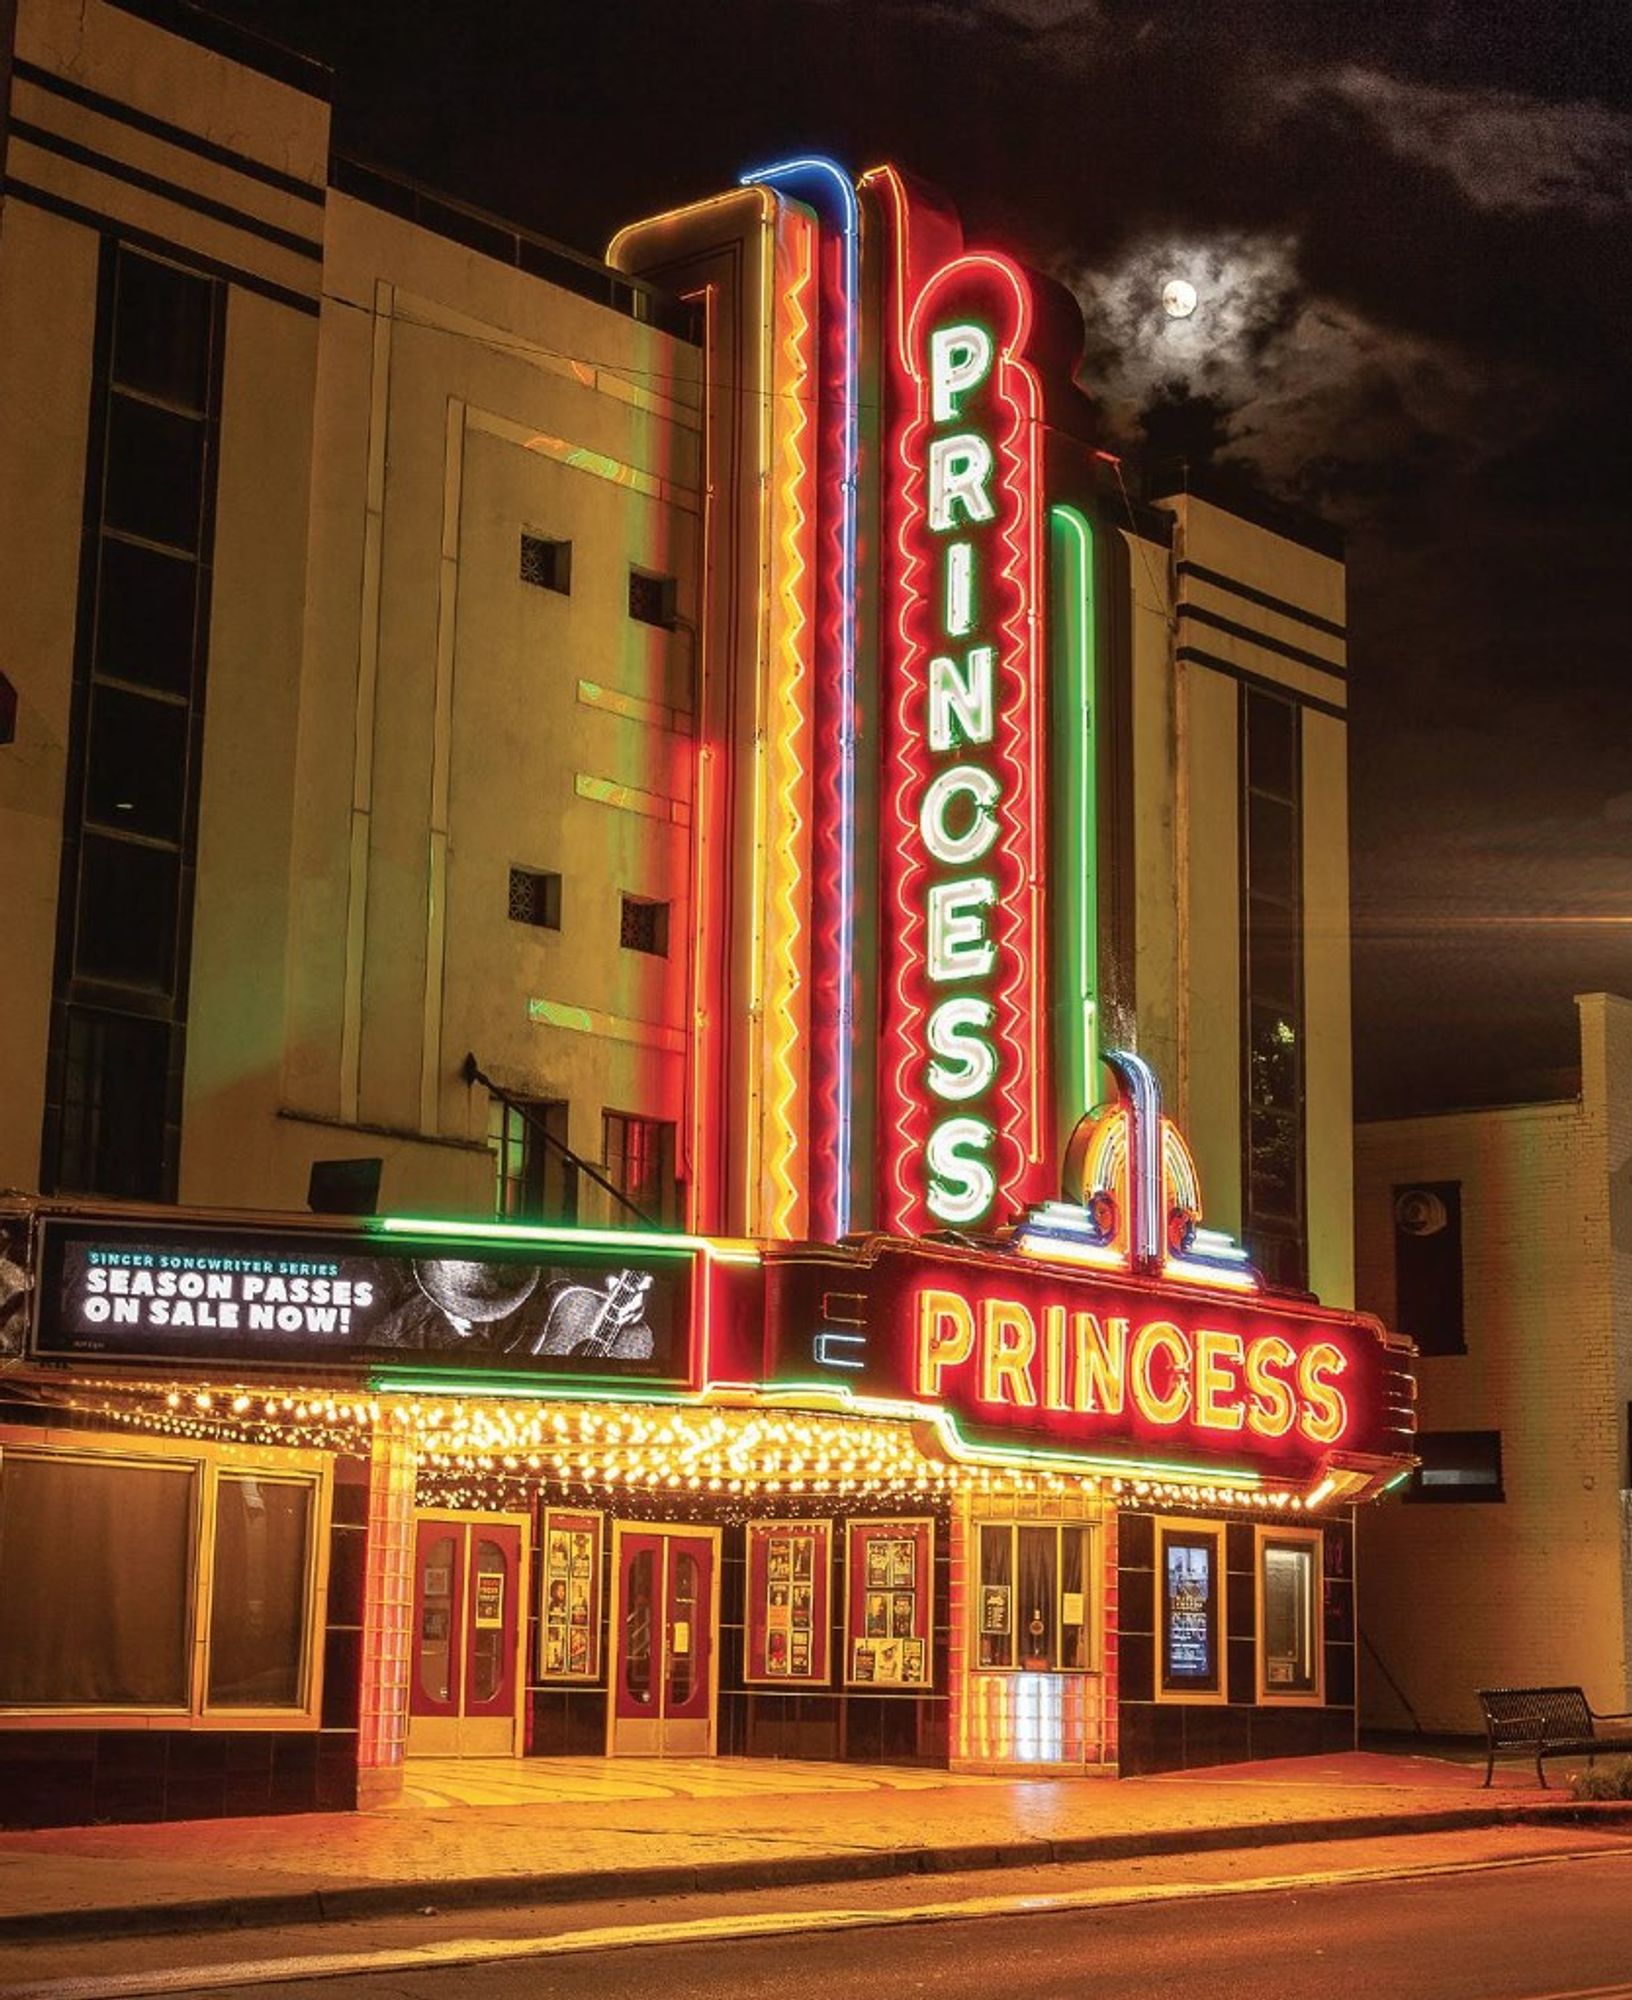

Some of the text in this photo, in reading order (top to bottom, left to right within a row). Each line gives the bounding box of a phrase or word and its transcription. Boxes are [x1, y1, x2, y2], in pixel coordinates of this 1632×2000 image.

[919, 323, 1000, 1224] PRINCESS
[89, 1252, 339, 1277] SINGER SONGWRITER SERIES
[86, 1267, 374, 1307] SEASON PASSES
[84, 1296, 351, 1334] ON SALE NOW!
[914, 1289, 1348, 1444] PRINCESS
